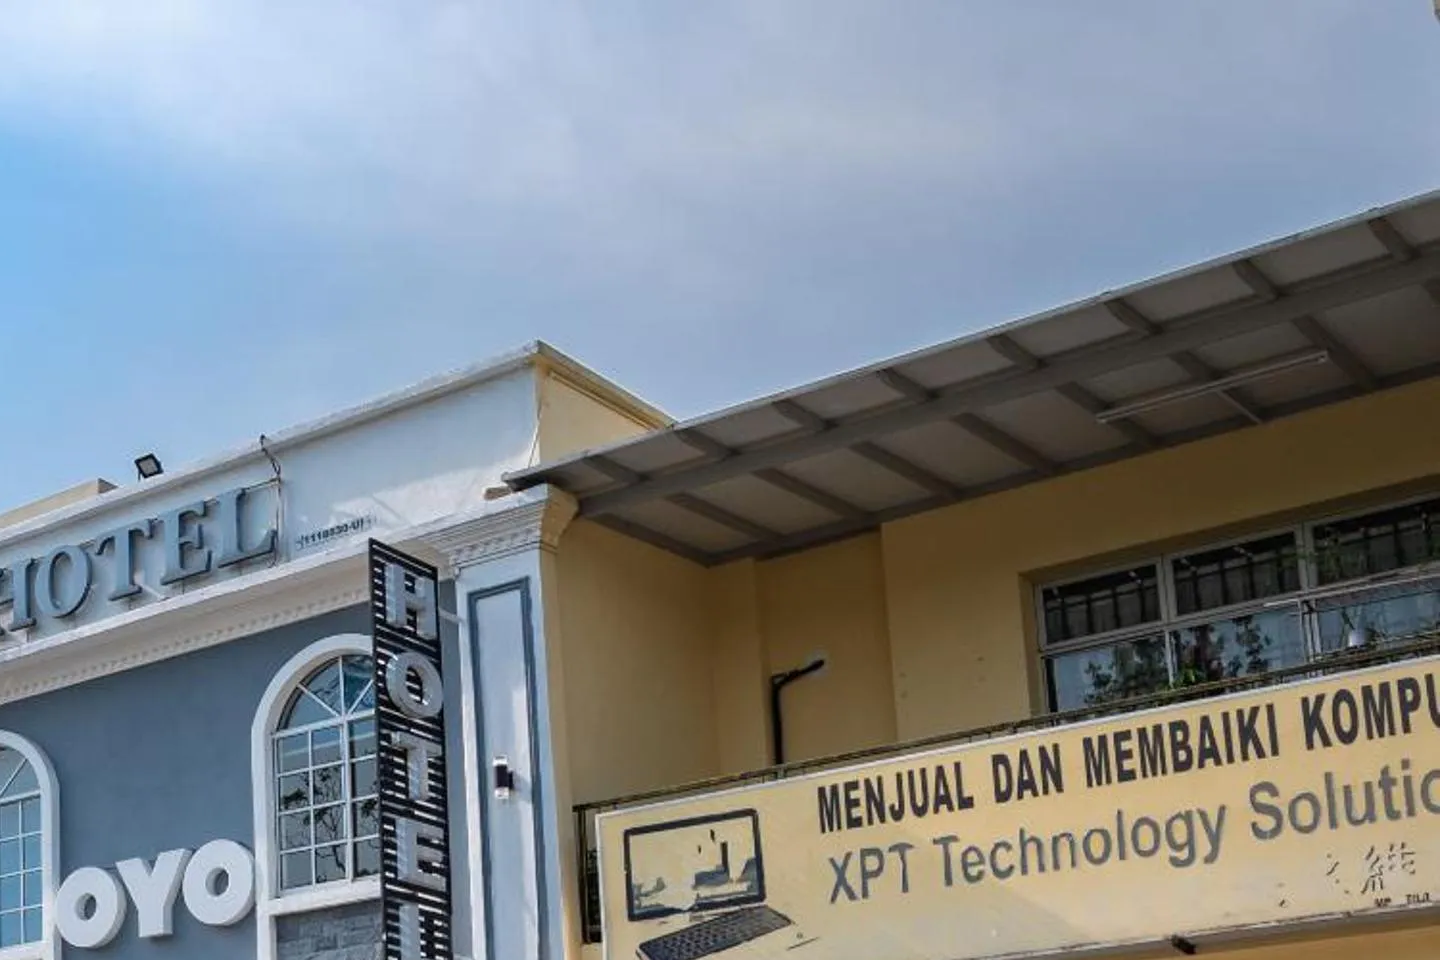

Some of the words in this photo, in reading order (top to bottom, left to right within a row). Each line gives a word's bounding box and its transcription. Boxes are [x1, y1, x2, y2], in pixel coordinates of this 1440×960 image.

[817, 761, 974, 833] MENJUAL
[991, 743, 1064, 803] DAN
[1082, 703, 1280, 789] MEMBAIKI
[56, 839, 256, 948] OYO
[829, 842, 914, 904] XPT
[932, 804, 1227, 887] Technology
